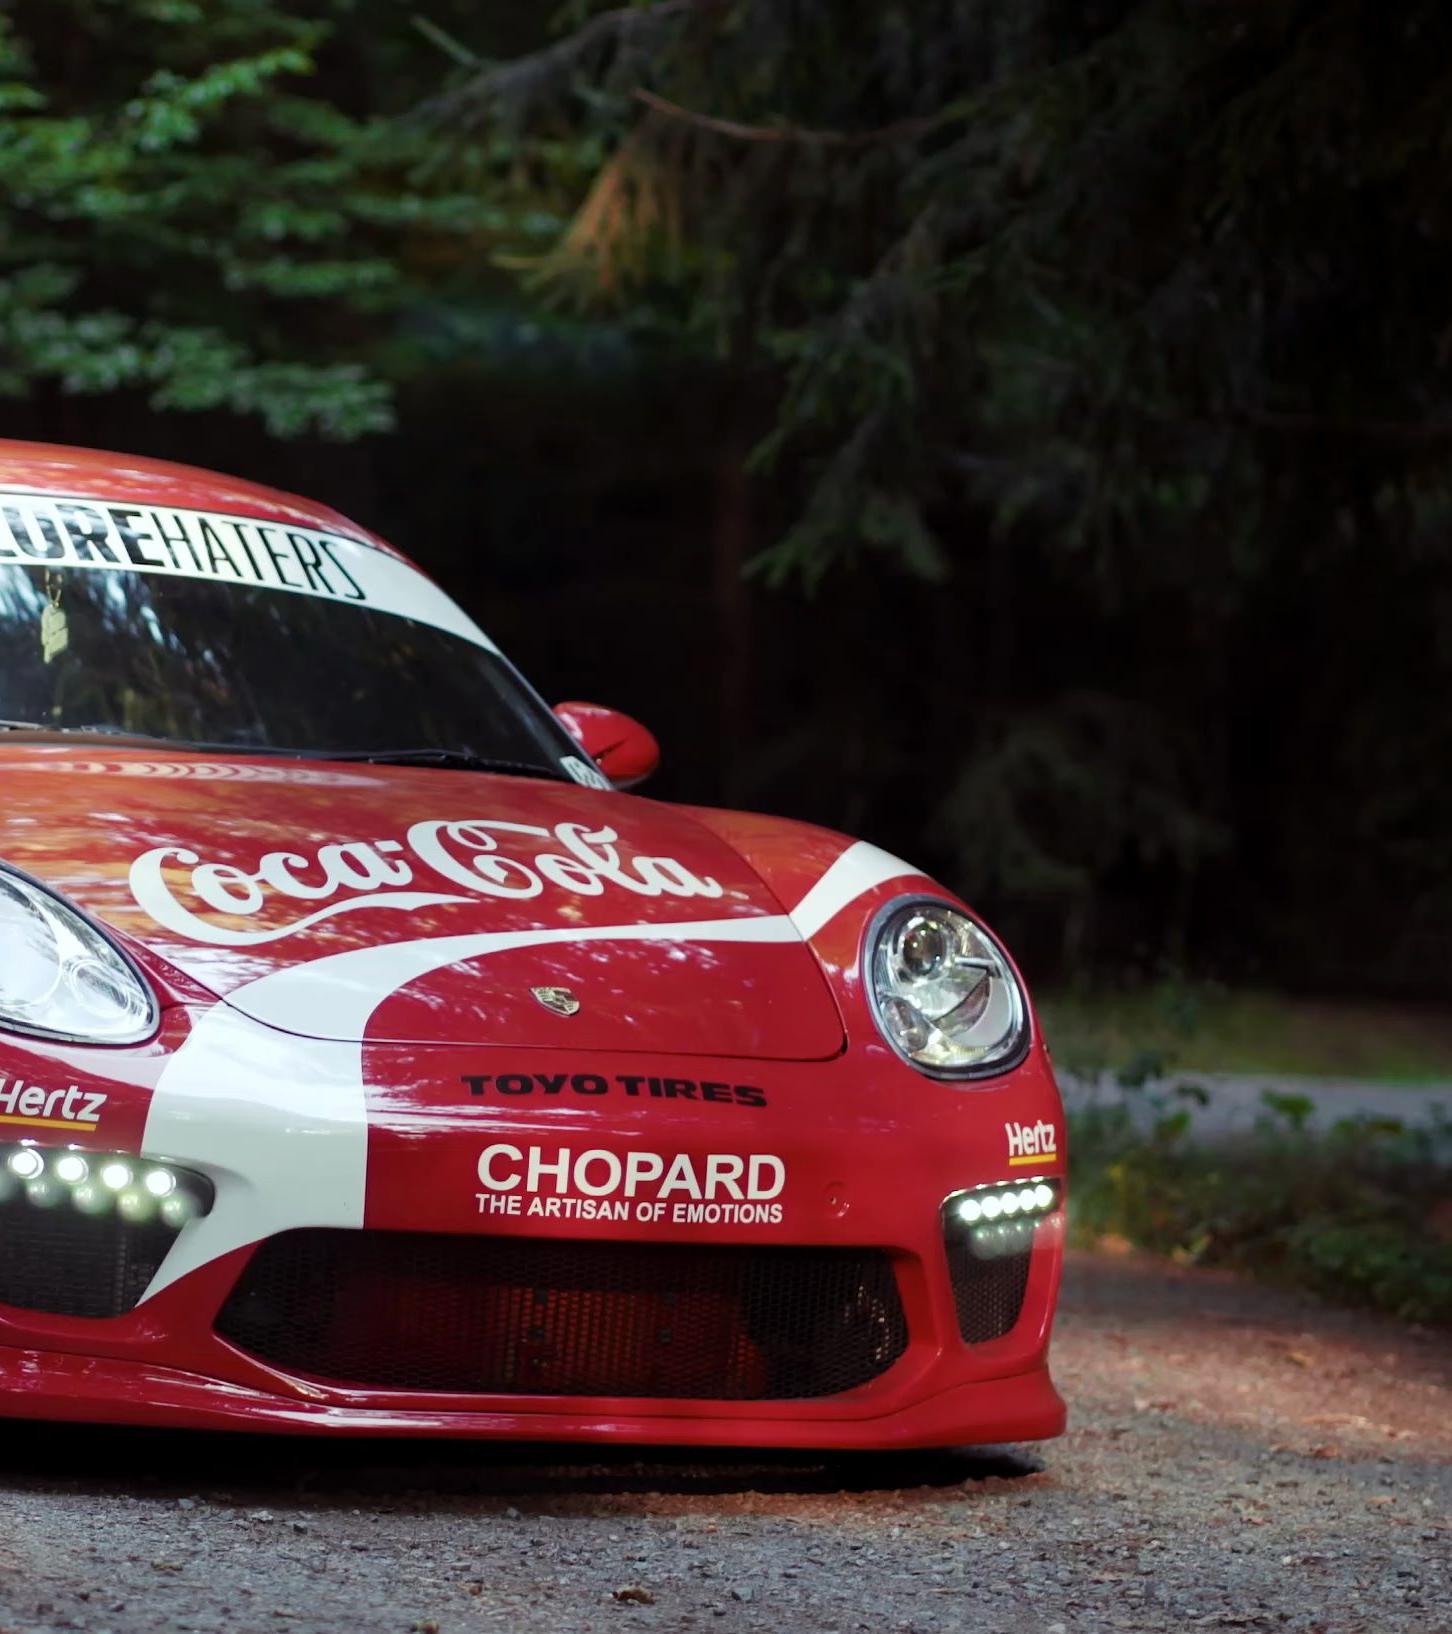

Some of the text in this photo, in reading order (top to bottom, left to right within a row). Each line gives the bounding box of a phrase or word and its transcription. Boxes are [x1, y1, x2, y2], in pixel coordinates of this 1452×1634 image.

[461, 1074, 768, 1107] TOYO TIRES
[1004, 1119, 1056, 1157] Hertz
[477, 1143, 786, 1200] CHOPARD
[475, 1193, 783, 1224] THE ARTISAN OF EMOTIONS
